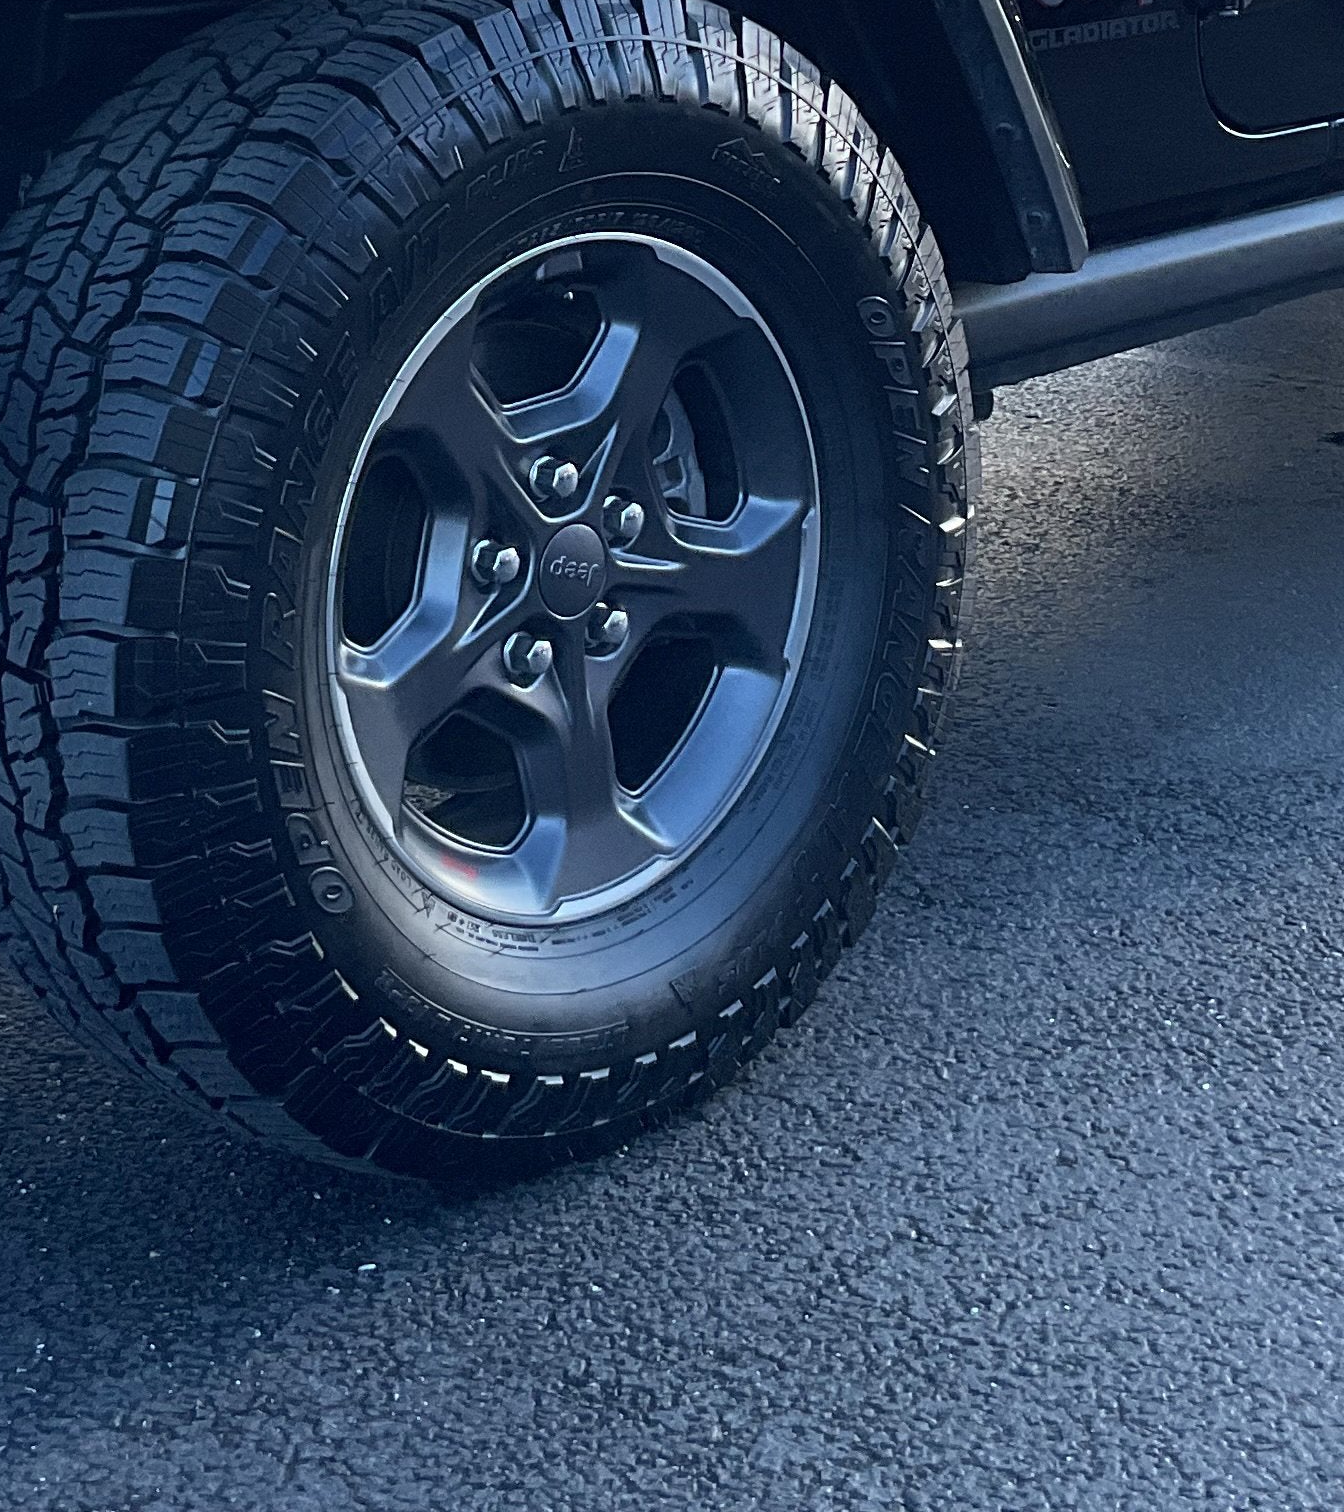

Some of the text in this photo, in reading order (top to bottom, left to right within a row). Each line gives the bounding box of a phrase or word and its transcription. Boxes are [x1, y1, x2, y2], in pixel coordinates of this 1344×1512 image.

[1027, 10, 1180, 52] GLADIATOR
[856, 295, 930, 488] OPEN
[549, 554, 600, 587] Jeep
[261, 689, 355, 914] OPEN
